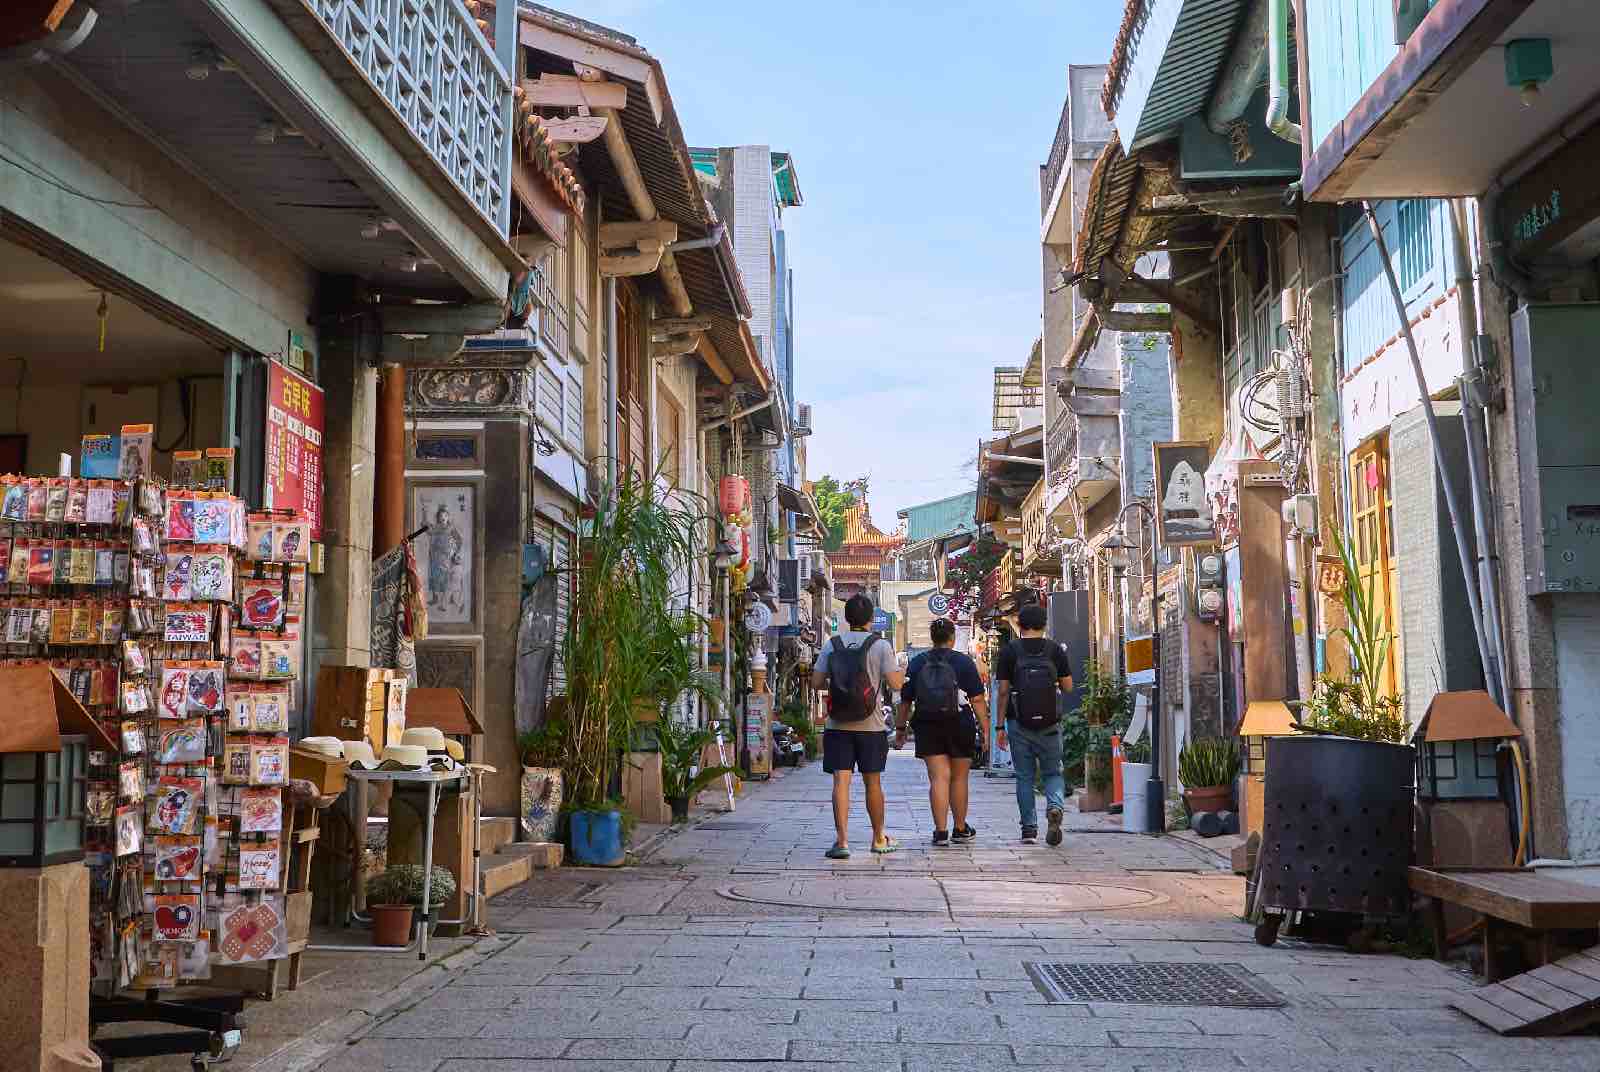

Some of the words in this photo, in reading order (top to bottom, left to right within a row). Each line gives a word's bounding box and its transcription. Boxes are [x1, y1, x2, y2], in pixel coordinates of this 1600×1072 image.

[282, 375, 311, 417] 古早味
[167, 632, 206, 640] TAIWAN
